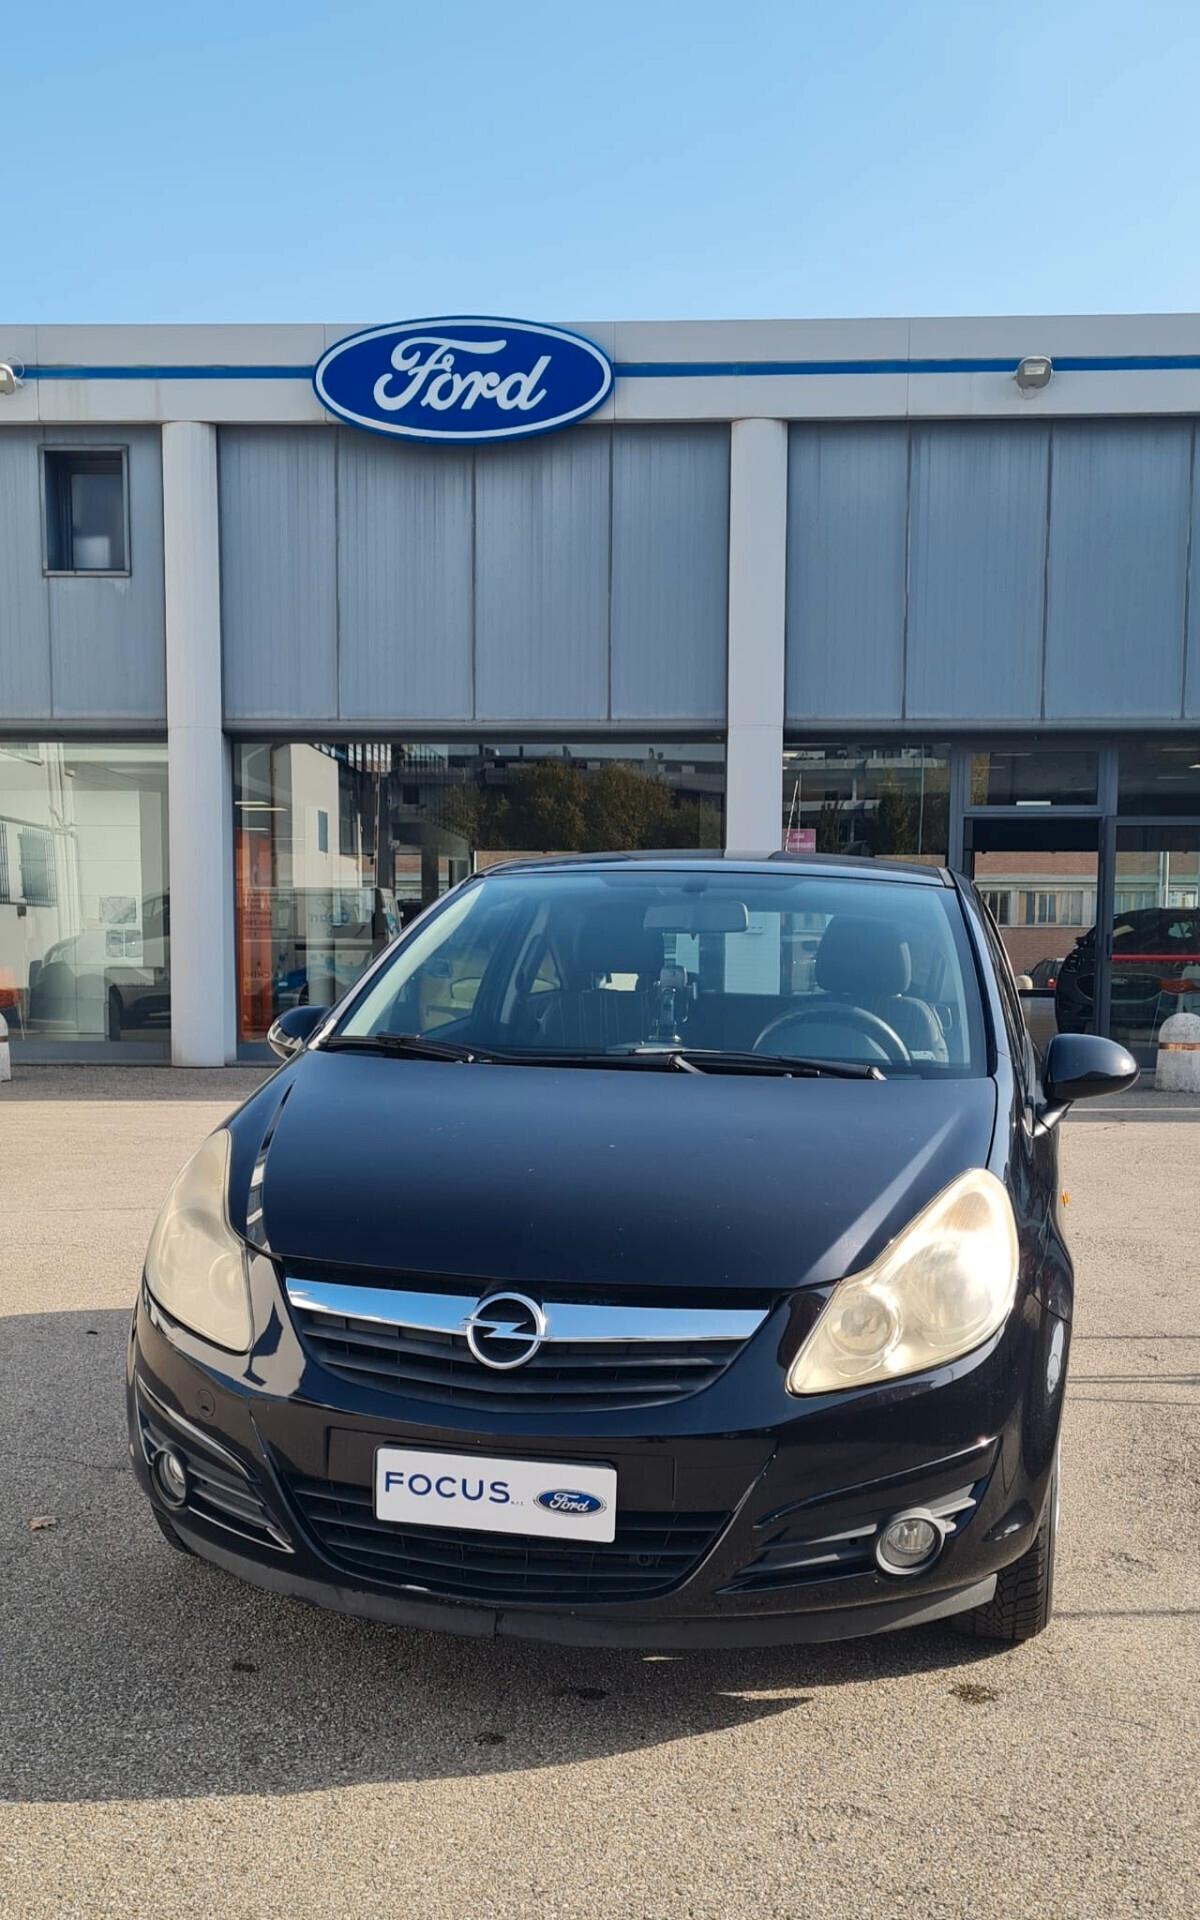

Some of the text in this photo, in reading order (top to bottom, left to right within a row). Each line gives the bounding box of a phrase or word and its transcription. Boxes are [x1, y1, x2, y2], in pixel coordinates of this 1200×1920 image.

[373, 336, 552, 411] Ford
[385, 1471, 510, 1504] FOCUS
[549, 1492, 590, 1512] Ford
